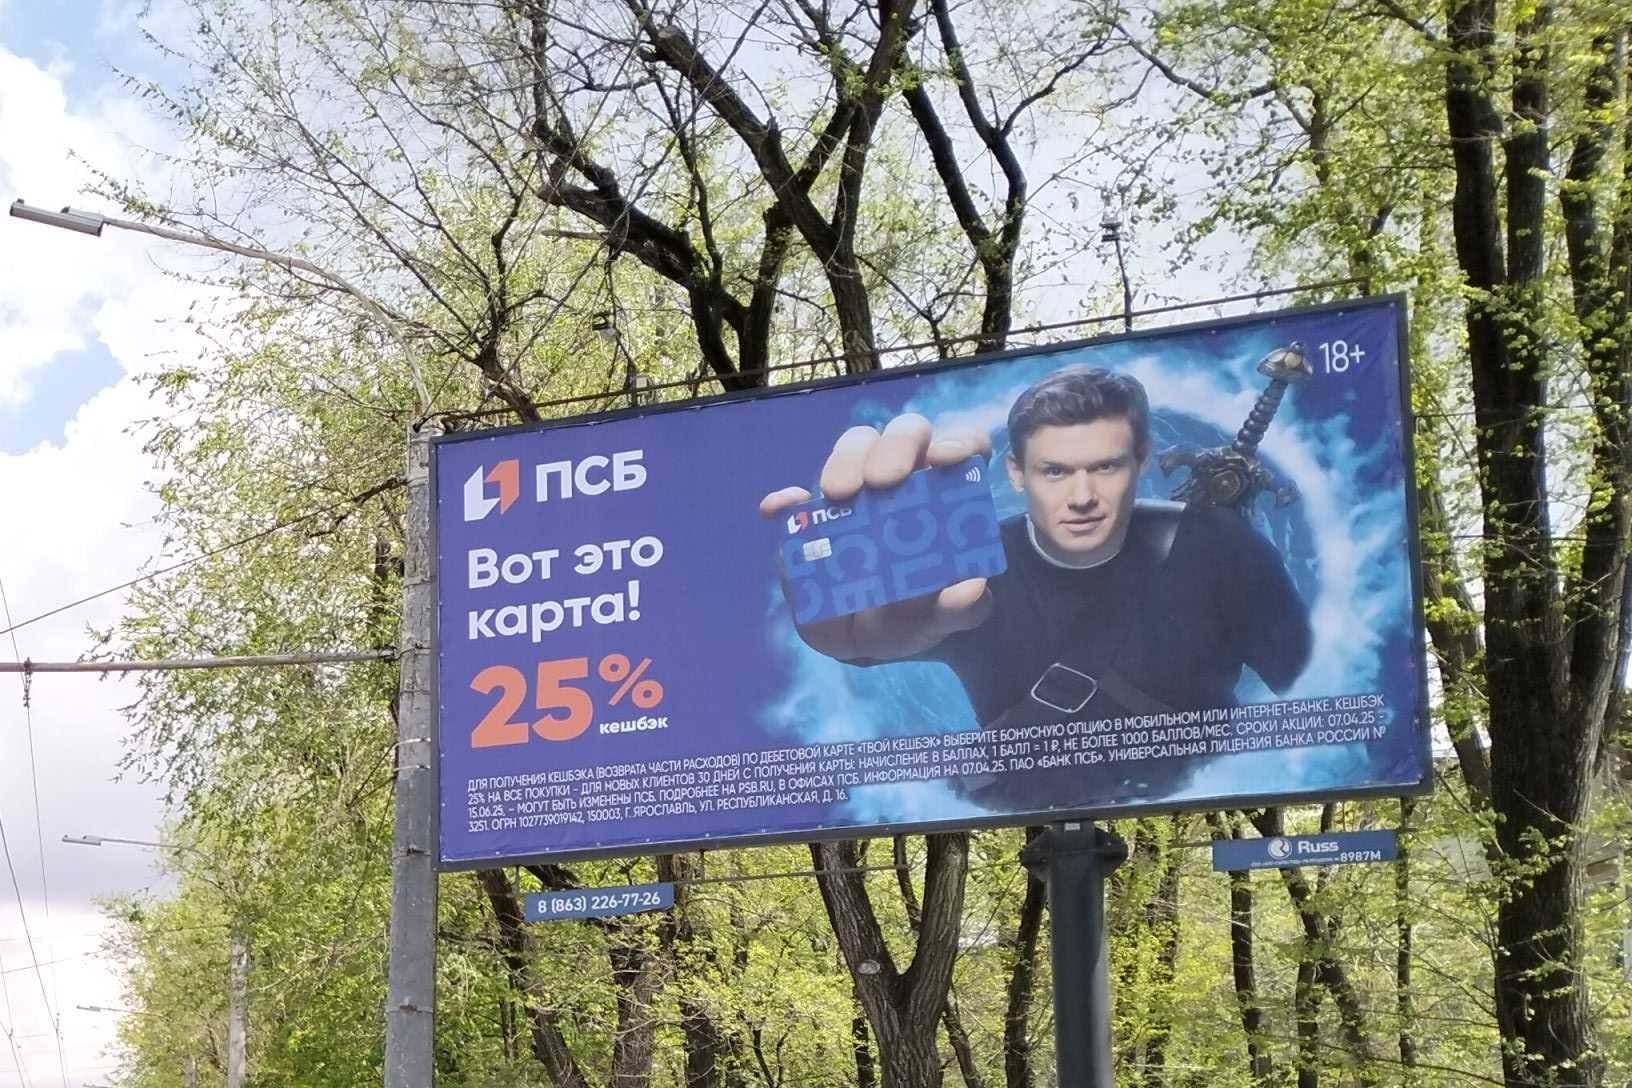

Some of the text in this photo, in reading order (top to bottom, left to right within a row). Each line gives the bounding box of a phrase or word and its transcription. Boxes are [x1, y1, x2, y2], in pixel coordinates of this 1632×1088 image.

[1319, 340, 1366, 374] 18+
[535, 449, 647, 503] ПСБ
[468, 535, 665, 590] Вот это
[468, 579, 641, 644] карта!
[469, 652, 665, 749] 25%
[599, 715, 669, 735] кешбэк
[467, 778, 488, 793] ДЛЯ
[489, 772, 547, 789] ПОЛУЧЕНИЯ
[547, 767, 595, 784] КЕШБЭКА
[595, 762, 647, 779] (ВОЗВРАТА
[648, 759, 682, 774] ЧАСТИ
[683, 753, 741, 771] РАСХОДОВ)
[742, 752, 759, 765] ПО
[759, 745, 820, 765] ДЕБЕТОВОЙ
[823, 742, 855, 757] КАРТЕ
[857, 738, 891, 754] «ТВОЙ
[892, 734, 941, 751] КЕШБЭК»
[943, 729, 998, 746] ВЫБЕРИТЕ
[1000, 723, 1065, 741] БОНУСНУЮ
[1066, 718, 1113, 735] ОПЦИЮ
[1114, 717, 1123, 730] В
[1124, 710, 1201, 729] МОБИЛЬНОМ
[1202, 708, 1228, 722] ИЛИ
[1335, 694, 1385, 710] КЕШБЭК
[467, 792, 486, 805] 25%
[487, 791, 502, 803] НА
[503, 789, 523, 802] ВСЕ
[524, 784, 571, 800] ПОКУПКИ
[580, 781, 602, 796] ДЛЯ
[604, 777, 640, 792] НОВЫХ
[642, 772, 695, 789] КЛИЕНТОВ
[697, 771, 711, 783] 30
[712, 767, 740, 784] ДНЕЙ
[742, 767, 752, 779] С
[754, 761, 816, 778] ПОЛУЧЕНИЯ
[858, 750, 929, 769] НАЧИСЛЕНИЕ
[931, 749, 940, 762] В
[999, 741, 1031, 756] БАЛЛ
[1063, 737, 1079, 751] НЕ
[1081, 733, 1119, 749] БОЛЕЕ
[1121, 731, 1149, 746] 1000
[1235, 719, 1279, 736] СРОКИ
[1328, 711, 1375, 728] 07.04.25
[517, 801, 550, 815] МОГУТ
[551, 798, 577, 812] БЫТЬ
[579, 793, 632, 809] ИЗМЕНЕНЫ
[659, 785, 719, 802] ПОДРОБНЕЕ
[721, 783, 736, 796] НА
[778, 779, 786, 791] В
[788, 774, 835, 790] ОФИСАХ
[864, 765, 941, 783] ИНФОРМАЦИЯ
[943, 763, 960, 776] НА
[1010, 757, 1035, 770] ПАО
[1036, 753, 1072, 768] «БАНК
[1108, 741, 1208, 762] УНИВЕРСАЛЬНАЯ
[1209, 736, 1272, 753] ЛИЦЕНЗИЯ
[1275, 732, 1314, 748] БАНКА
[1317, 727, 1369, 744] РОССИИ
[1373, 726, 1387, 740] №
[491, 817, 517, 831] ОГРН
[624, 807, 632, 819] Г.
[822, 789, 834, 803] Д.
[1298, 840, 1339, 854] Russ
[538, 891, 661, 913] 8 (863) 226-77-26
